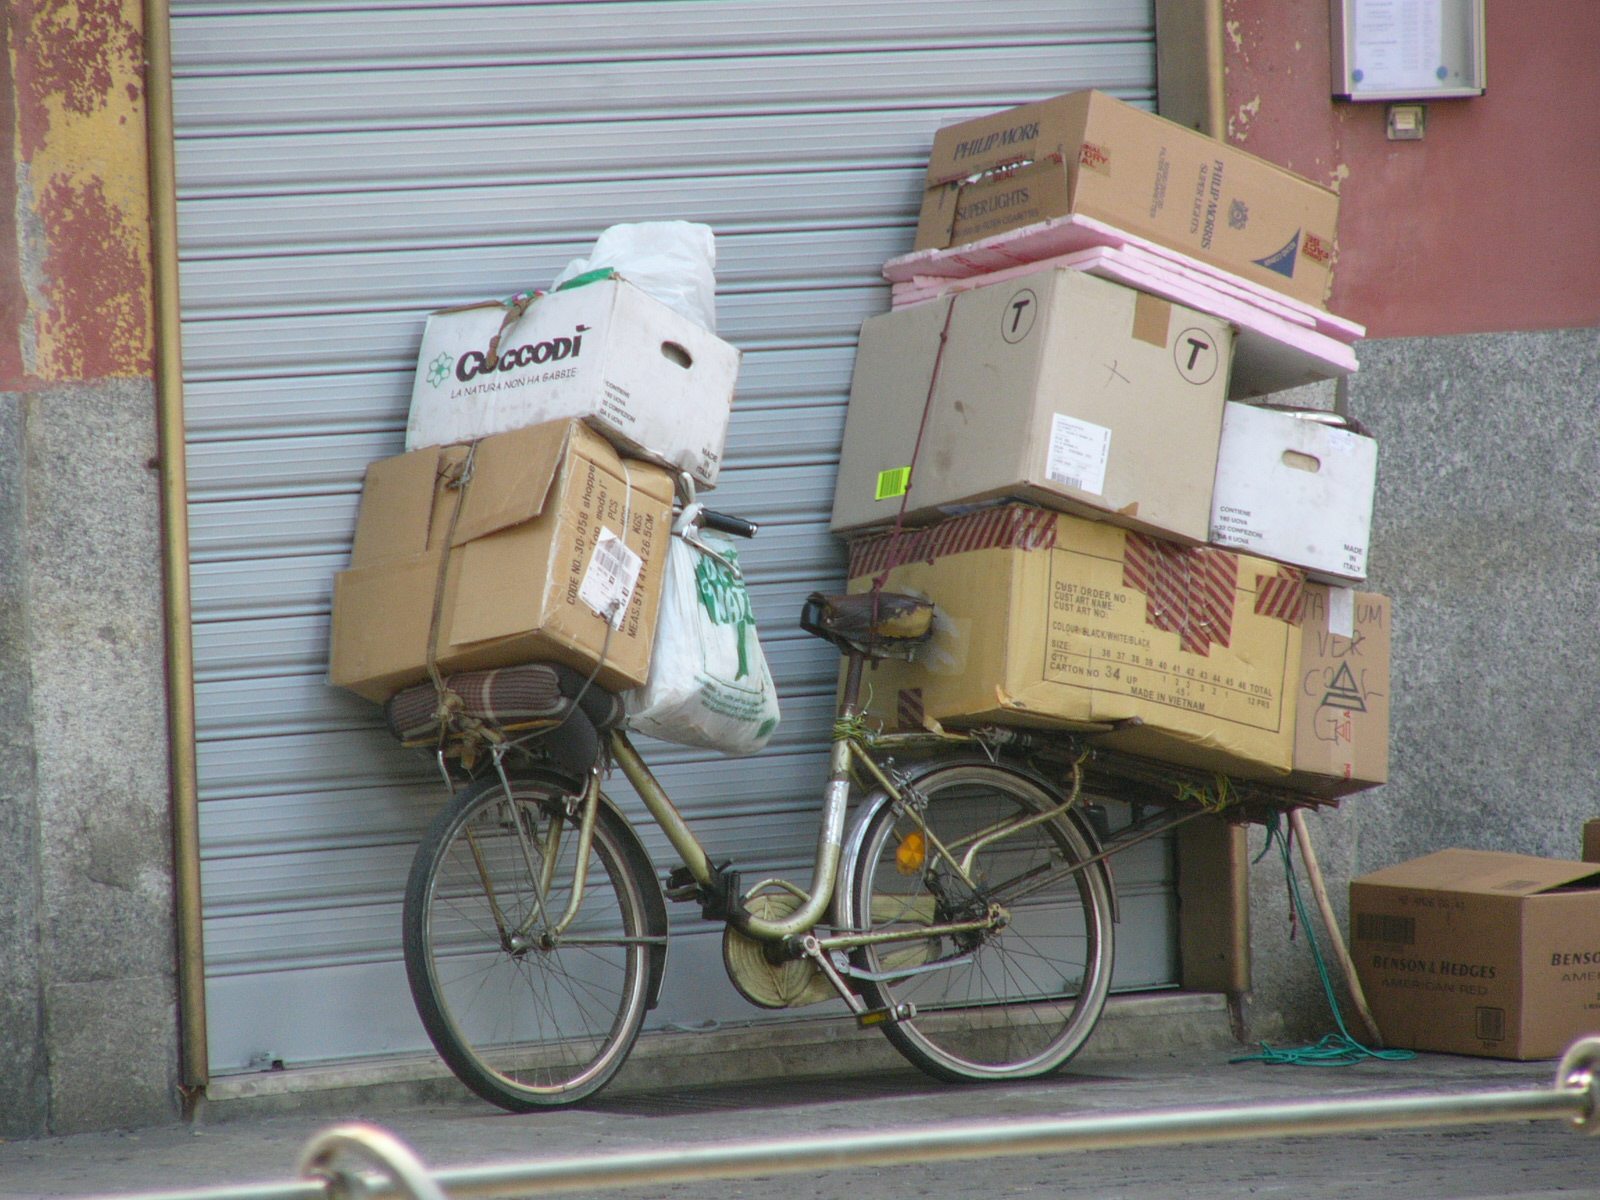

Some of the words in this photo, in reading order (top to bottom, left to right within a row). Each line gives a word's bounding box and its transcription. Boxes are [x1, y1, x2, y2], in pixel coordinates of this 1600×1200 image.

[953, 131, 1000, 161] PHILIP
[1196, 163, 1208, 197] SUPER
[1209, 159, 1225, 201] PHILIP
[988, 187, 1030, 212] LIGHTS
[1190, 197, 1201, 235] LIGHTS
[1201, 199, 1217, 250] MORRIS
[1012, 299, 1031, 333] T
[1187, 337, 1209, 370] T
[450, 389, 462, 399] LA
[464, 382, 502, 396] NATURA
[503, 376, 526, 391] NON
[527, 374, 540, 385] HA
[542, 367, 577, 383] GABBIE
[607, 498, 619, 521] PCS
[1220, 506, 1251, 517] CONTIENE
[566, 576, 579, 606] CODE
[582, 459, 596, 509] shopper
[632, 512, 643, 535] KGS
[1344, 543, 1363, 556] MADE
[1343, 562, 1361, 573] ITALY
[1054, 591, 1073, 602] CUST
[1075, 595, 1089, 606] ART
[1055, 580, 1078, 593] CUST
[1080, 586, 1111, 600] ORDER
[1053, 600, 1075, 611] CUST
[1076, 605, 1092, 616] ART
[1050, 661, 1085, 675] CARTON
[1105, 665, 1121, 681] 34
[1126, 675, 1138, 684] UP
[1117, 652, 1126, 660] 37
[1159, 661, 1168, 670] 40
[1186, 667, 1195, 677] 42
[1213, 673, 1221, 683] 44
[1226, 677, 1234, 687] 45
[1250, 683, 1273, 698] TOTAL
[1130, 685, 1154, 700] MADE
[1157, 692, 1166, 702] IN
[1168, 694, 1206, 711] VIETNAM
[1440, 960, 1497, 979] HEDGES
